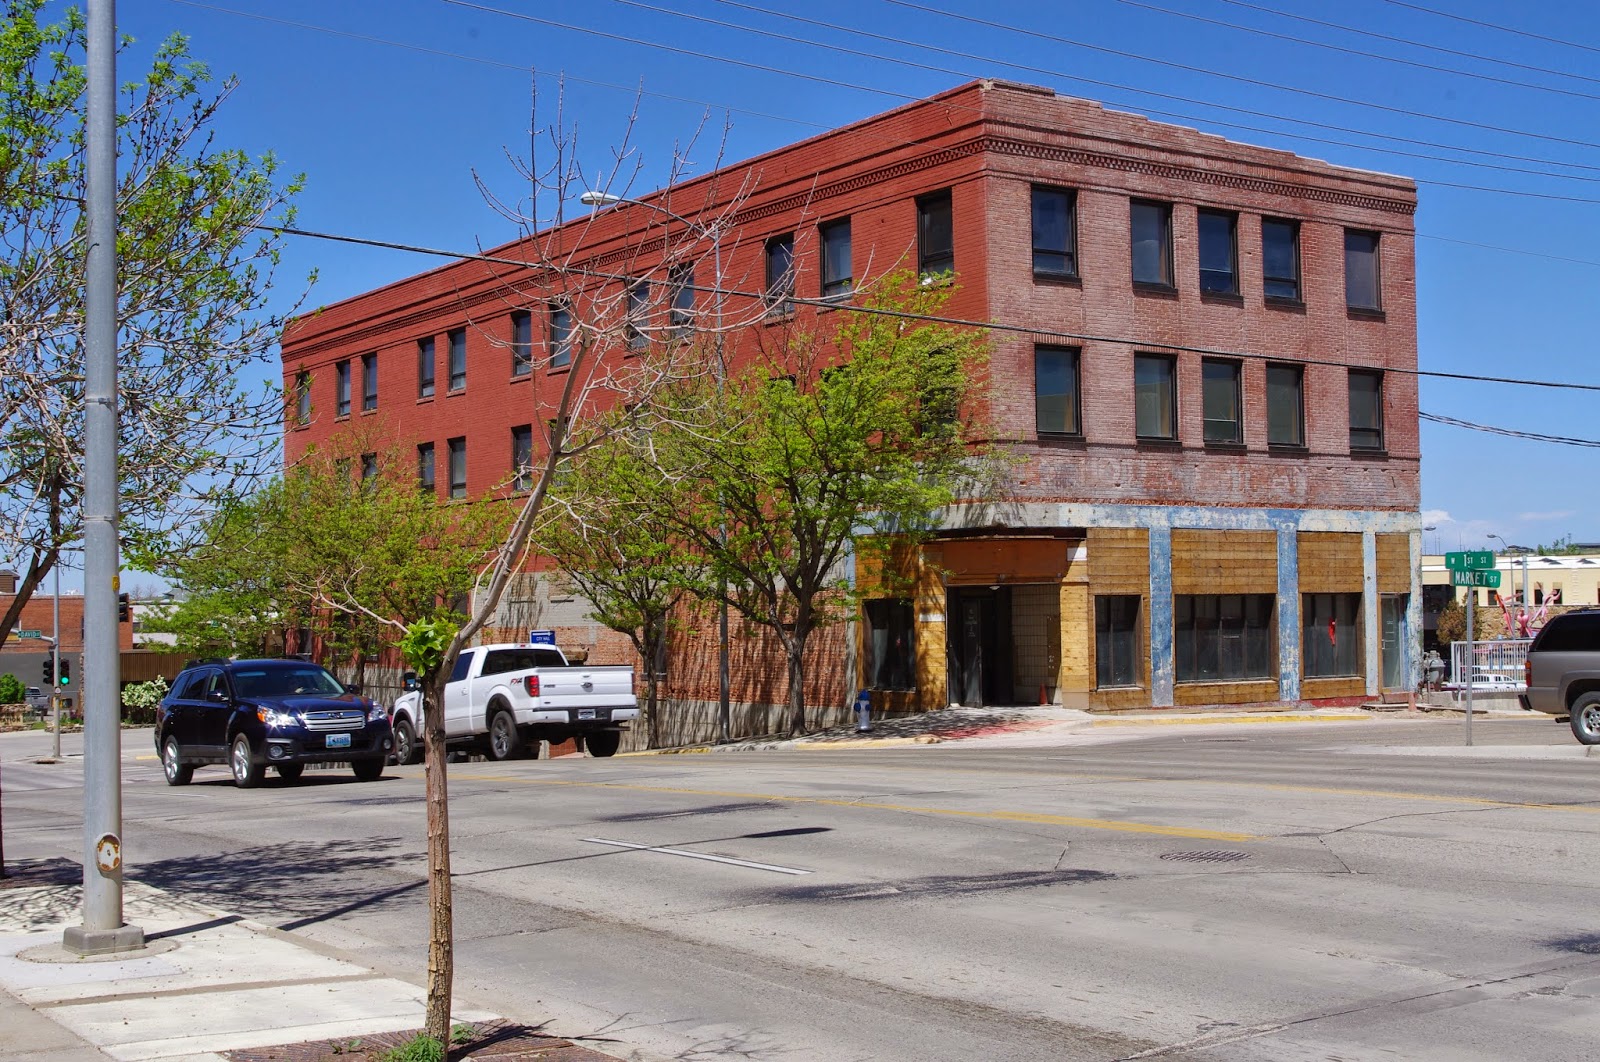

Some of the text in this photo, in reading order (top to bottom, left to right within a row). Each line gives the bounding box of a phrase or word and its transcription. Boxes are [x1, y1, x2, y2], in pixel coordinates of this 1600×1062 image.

[1464, 554, 1473, 567] 1ST
[1480, 556, 1487, 564] ST
[1455, 571, 1497, 585] MARKET ST
[510, 677, 523, 685] FX4
